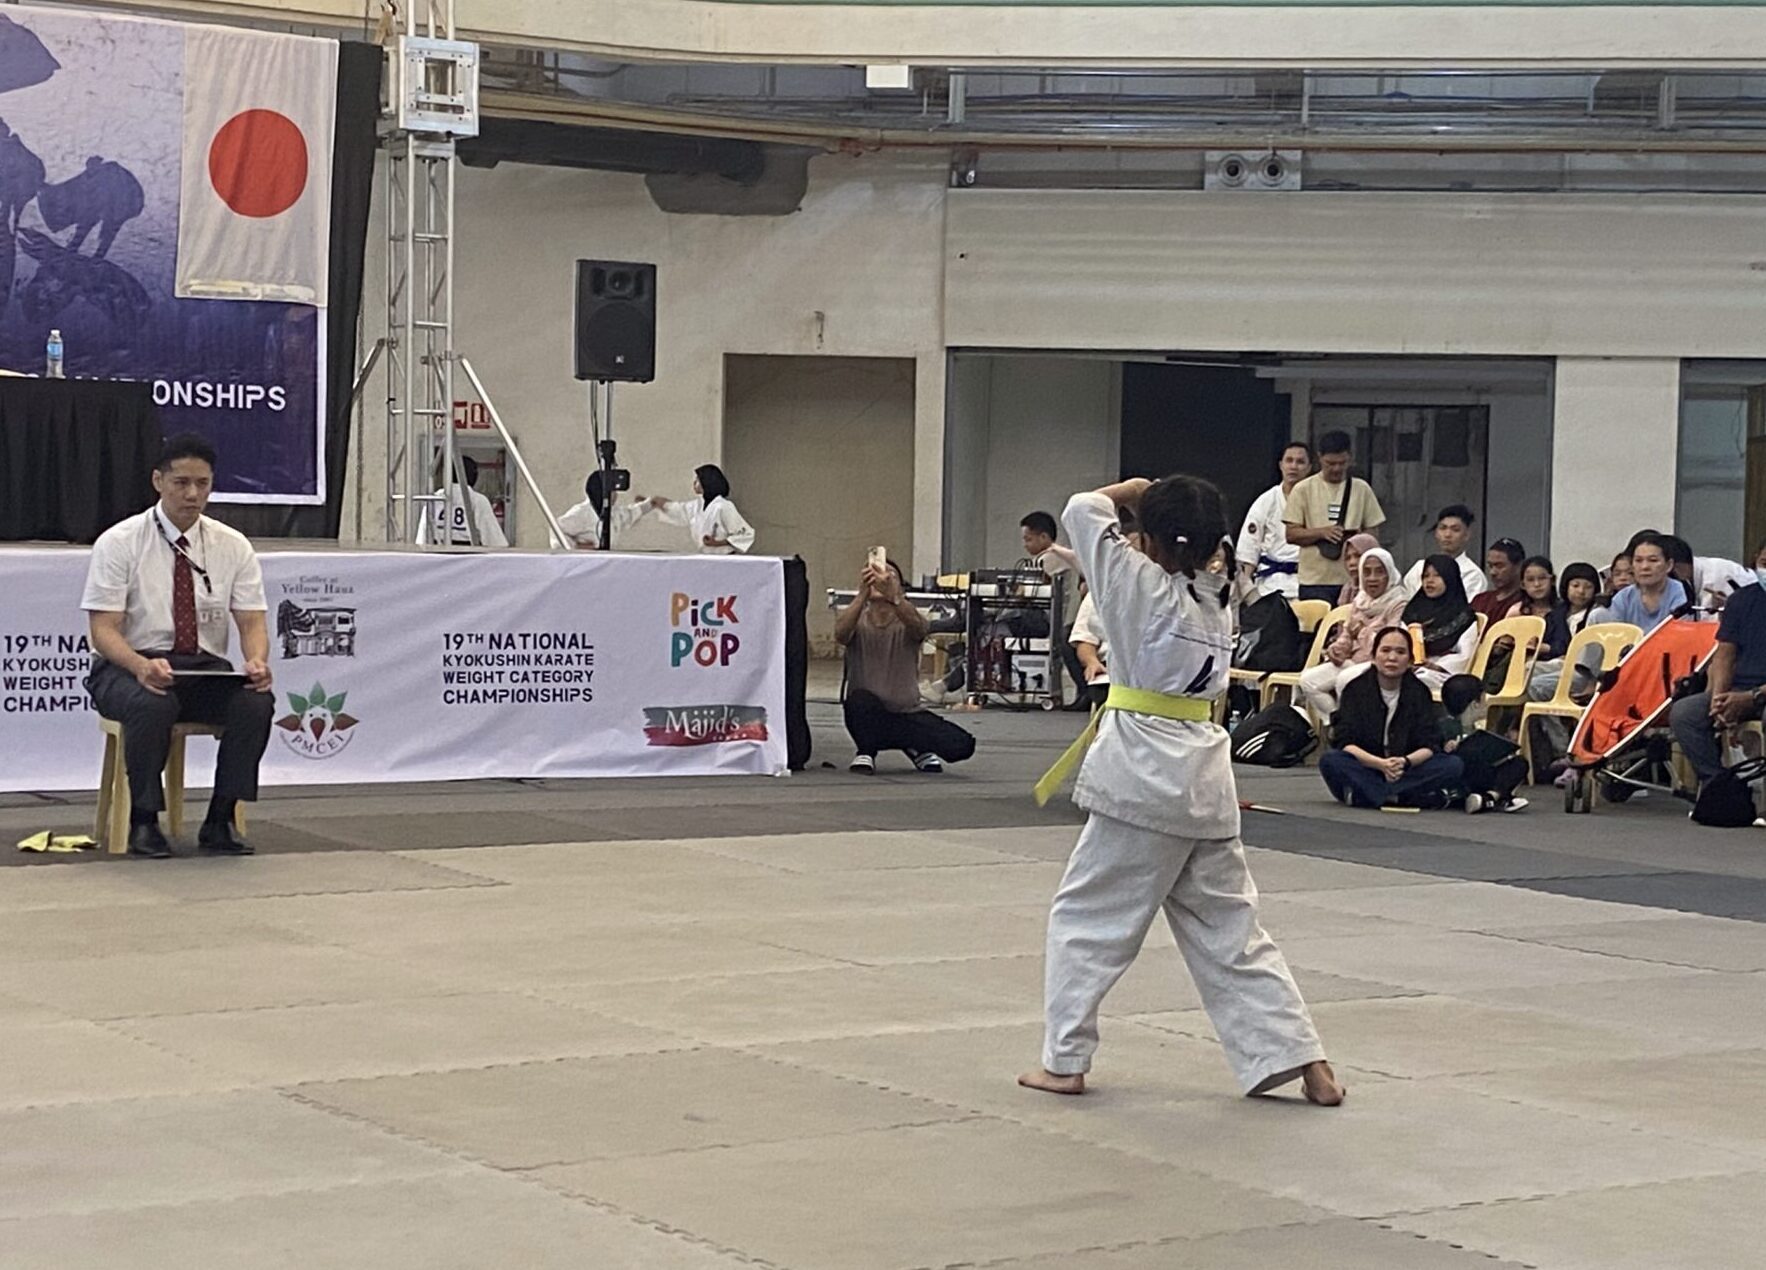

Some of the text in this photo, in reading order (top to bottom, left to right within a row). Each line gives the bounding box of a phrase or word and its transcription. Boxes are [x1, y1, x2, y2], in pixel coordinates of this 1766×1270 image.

[281, 583, 319, 594] Yellow
[693, 628, 718, 638] AND
[4, 635, 90, 653] 19TH NA
[443, 633, 594, 650] 19TH NATIONAL
[671, 631, 740, 667] POP
[3, 658, 90, 672] KYOKUSH
[443, 653, 594, 667] KYOKUSHIN KARATE
[3, 676, 77, 690] WEIGHT
[443, 670, 594, 684] WEIGHT CATEGORY
[443, 688, 593, 704] CHAMPIONSHIPS
[291, 734, 344, 754] PMCEI
